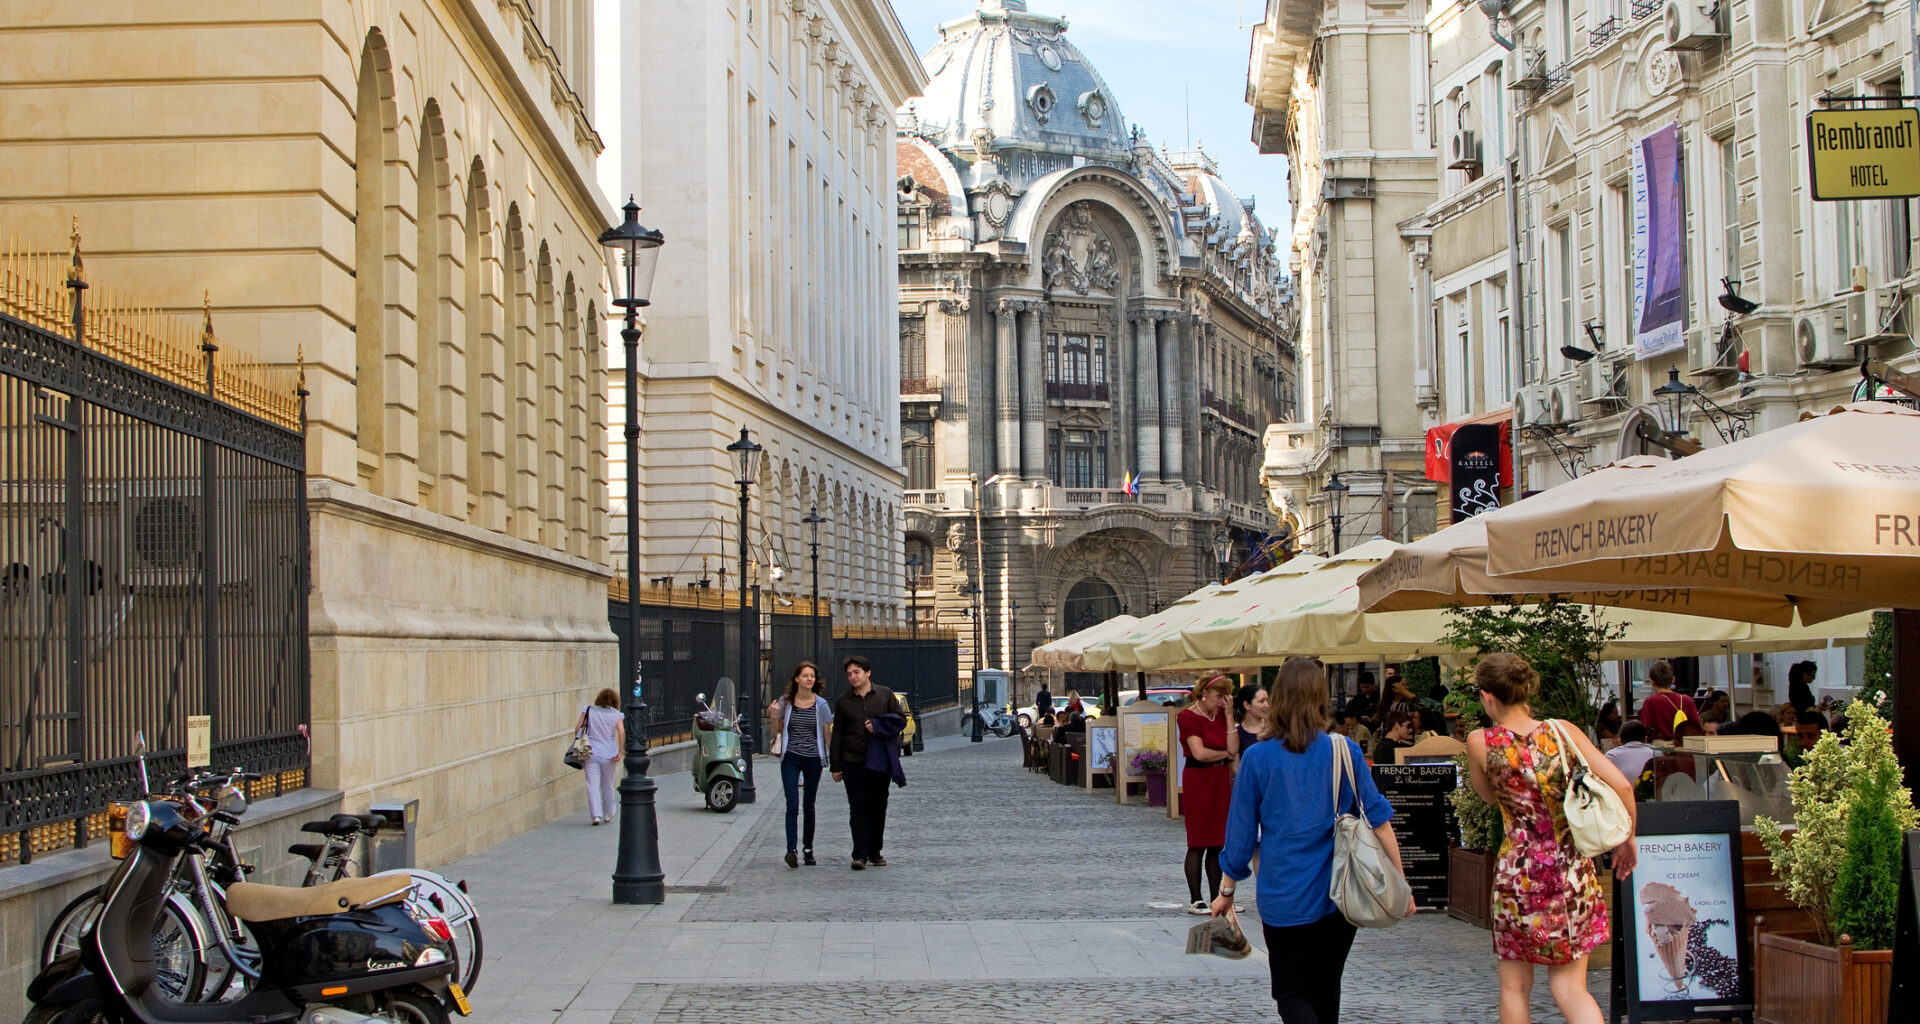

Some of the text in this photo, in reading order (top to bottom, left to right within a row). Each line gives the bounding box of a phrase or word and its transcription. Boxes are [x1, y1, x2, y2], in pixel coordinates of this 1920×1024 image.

[1850, 165, 1888, 187] HOTEL
[1534, 512, 1658, 560] FRENCH BAKERY
[1875, 514, 1920, 546] FR
[1399, 554, 1425, 580] BAKERY
[1380, 766, 1453, 775] FRENCH BAKERY
[1640, 842, 1722, 854] FRENCH BAKERY
[366, 957, 408, 972] Vespa
